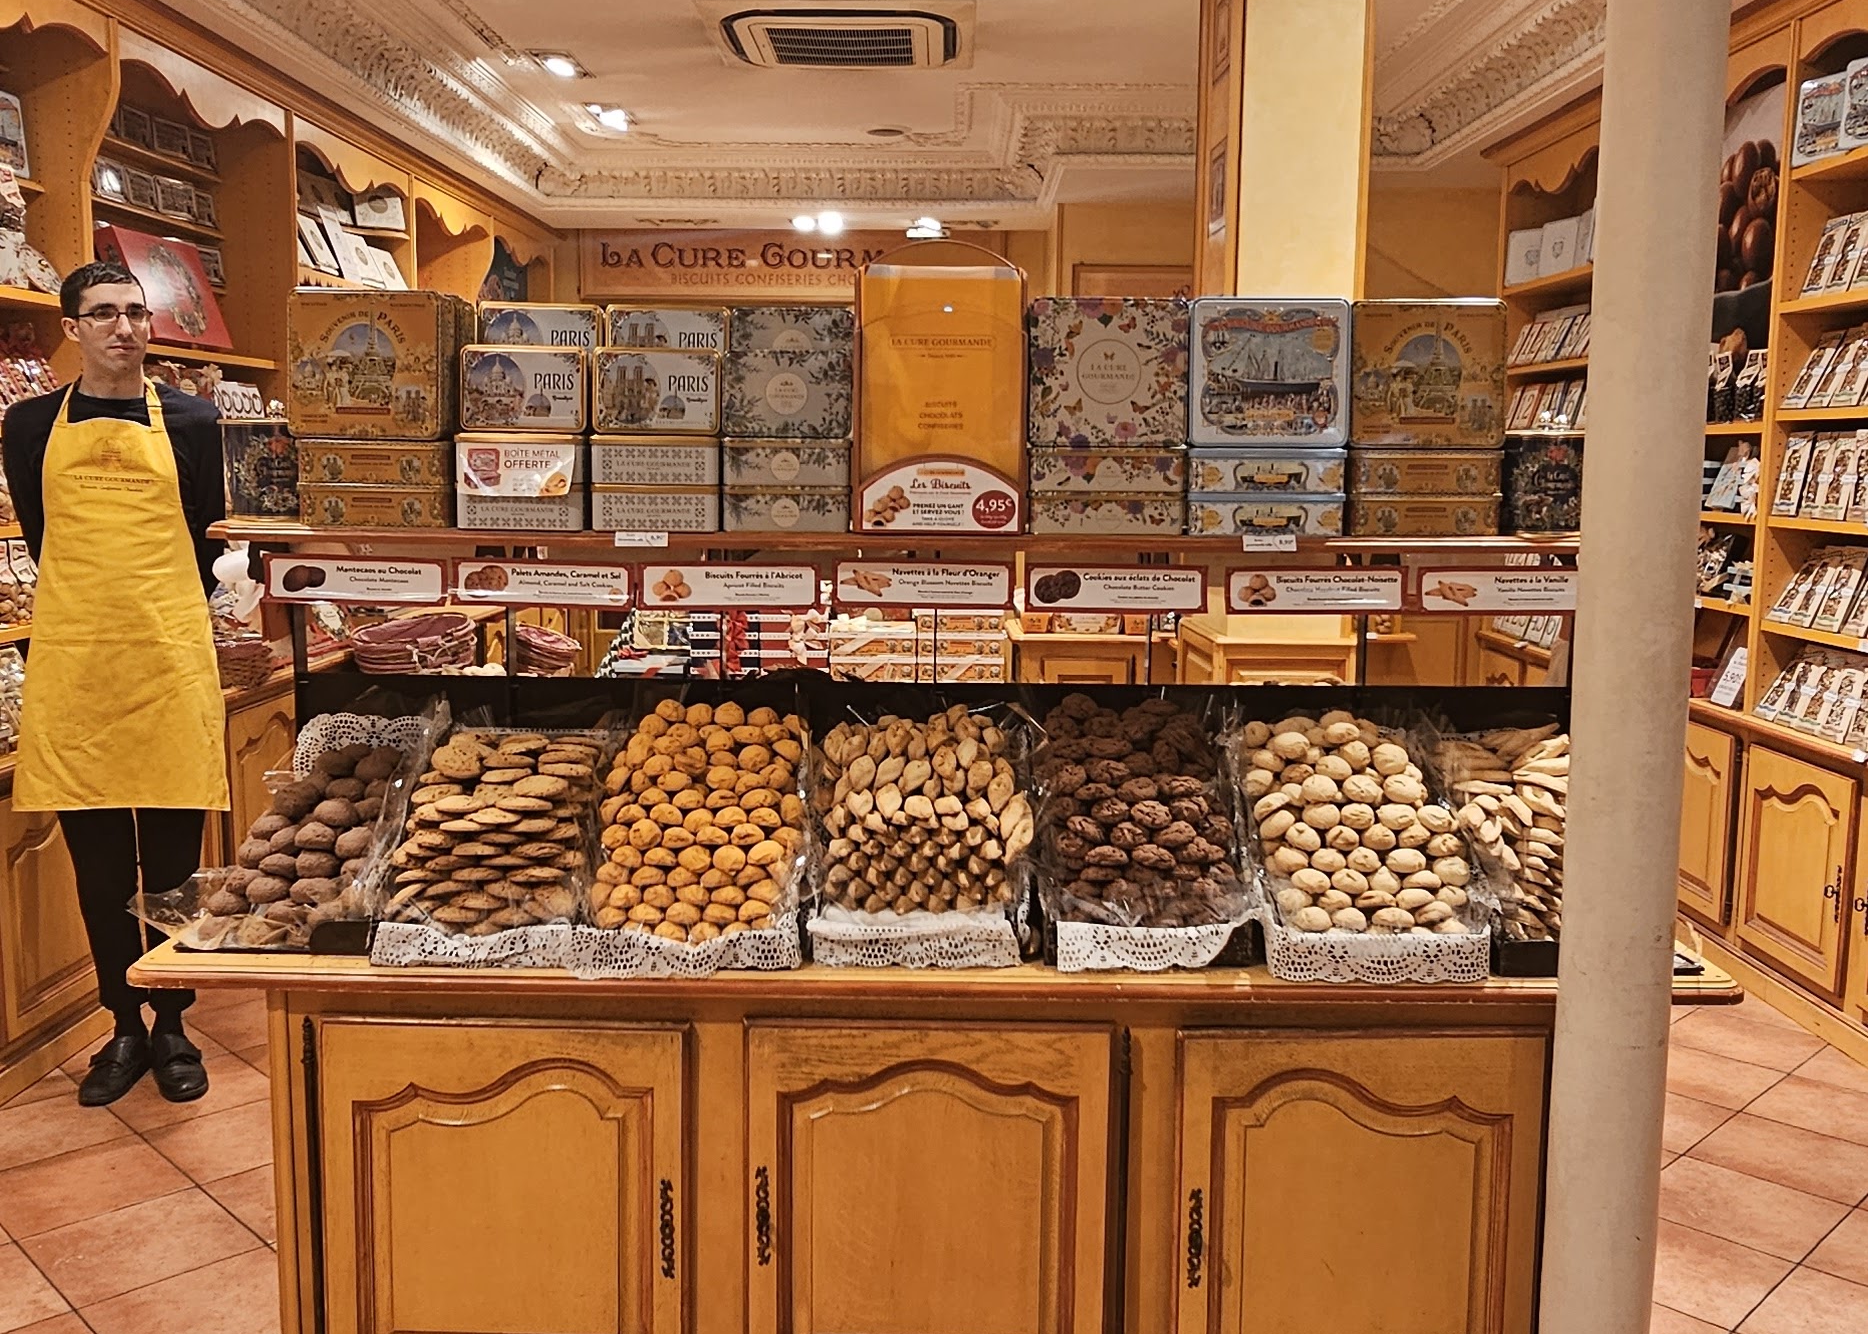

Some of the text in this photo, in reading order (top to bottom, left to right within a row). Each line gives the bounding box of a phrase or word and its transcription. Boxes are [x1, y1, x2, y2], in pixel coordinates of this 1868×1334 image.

[601, 242, 643, 267] LA
[652, 242, 746, 268] CURE
[671, 273, 730, 285] BISCUITS
[736, 273, 822, 286] CONFISERIES
[377, 311, 406, 345] PARIS
[550, 330, 590, 347] PARIS
[678, 332, 718, 348] PARIS
[904, 338, 929, 347] CURE
[931, 338, 993, 347] GOURMANDE
[1443, 322, 1472, 355] PARIS
[533, 372, 575, 391] PARIS
[668, 375, 709, 392] PARIS
[532, 448, 560, 459] MÉTAL
[503, 460, 551, 469] OFFERTE
[910, 478, 972, 490] Les Biscuits
[336, 566, 377, 574] Mantecaos
[388, 567, 422, 575] Chocolat
[511, 568, 532, 577] Palets
[535, 570, 569, 579] Amandes,
[570, 570, 600, 579] Caramel
[601, 571, 609, 579] et
[705, 571, 803, 579] Biscuits Fourrés à l'Abricot
[892, 568, 1000, 580] Navettes à la Fleur d'Oranger
[898, 578, 920, 587] Orange
[1083, 573, 1112, 581] Cookies
[1128, 573, 1150, 582] éclats
[1151, 573, 1161, 582] de
[1162, 573, 1196, 582] Chocolat
[1276, 575, 1303, 583] Biscuits
[1304, 575, 1331, 583] Fourrés
[1494, 576, 1527, 584] Navettes
[1543, 575, 1569, 584] Vanille
